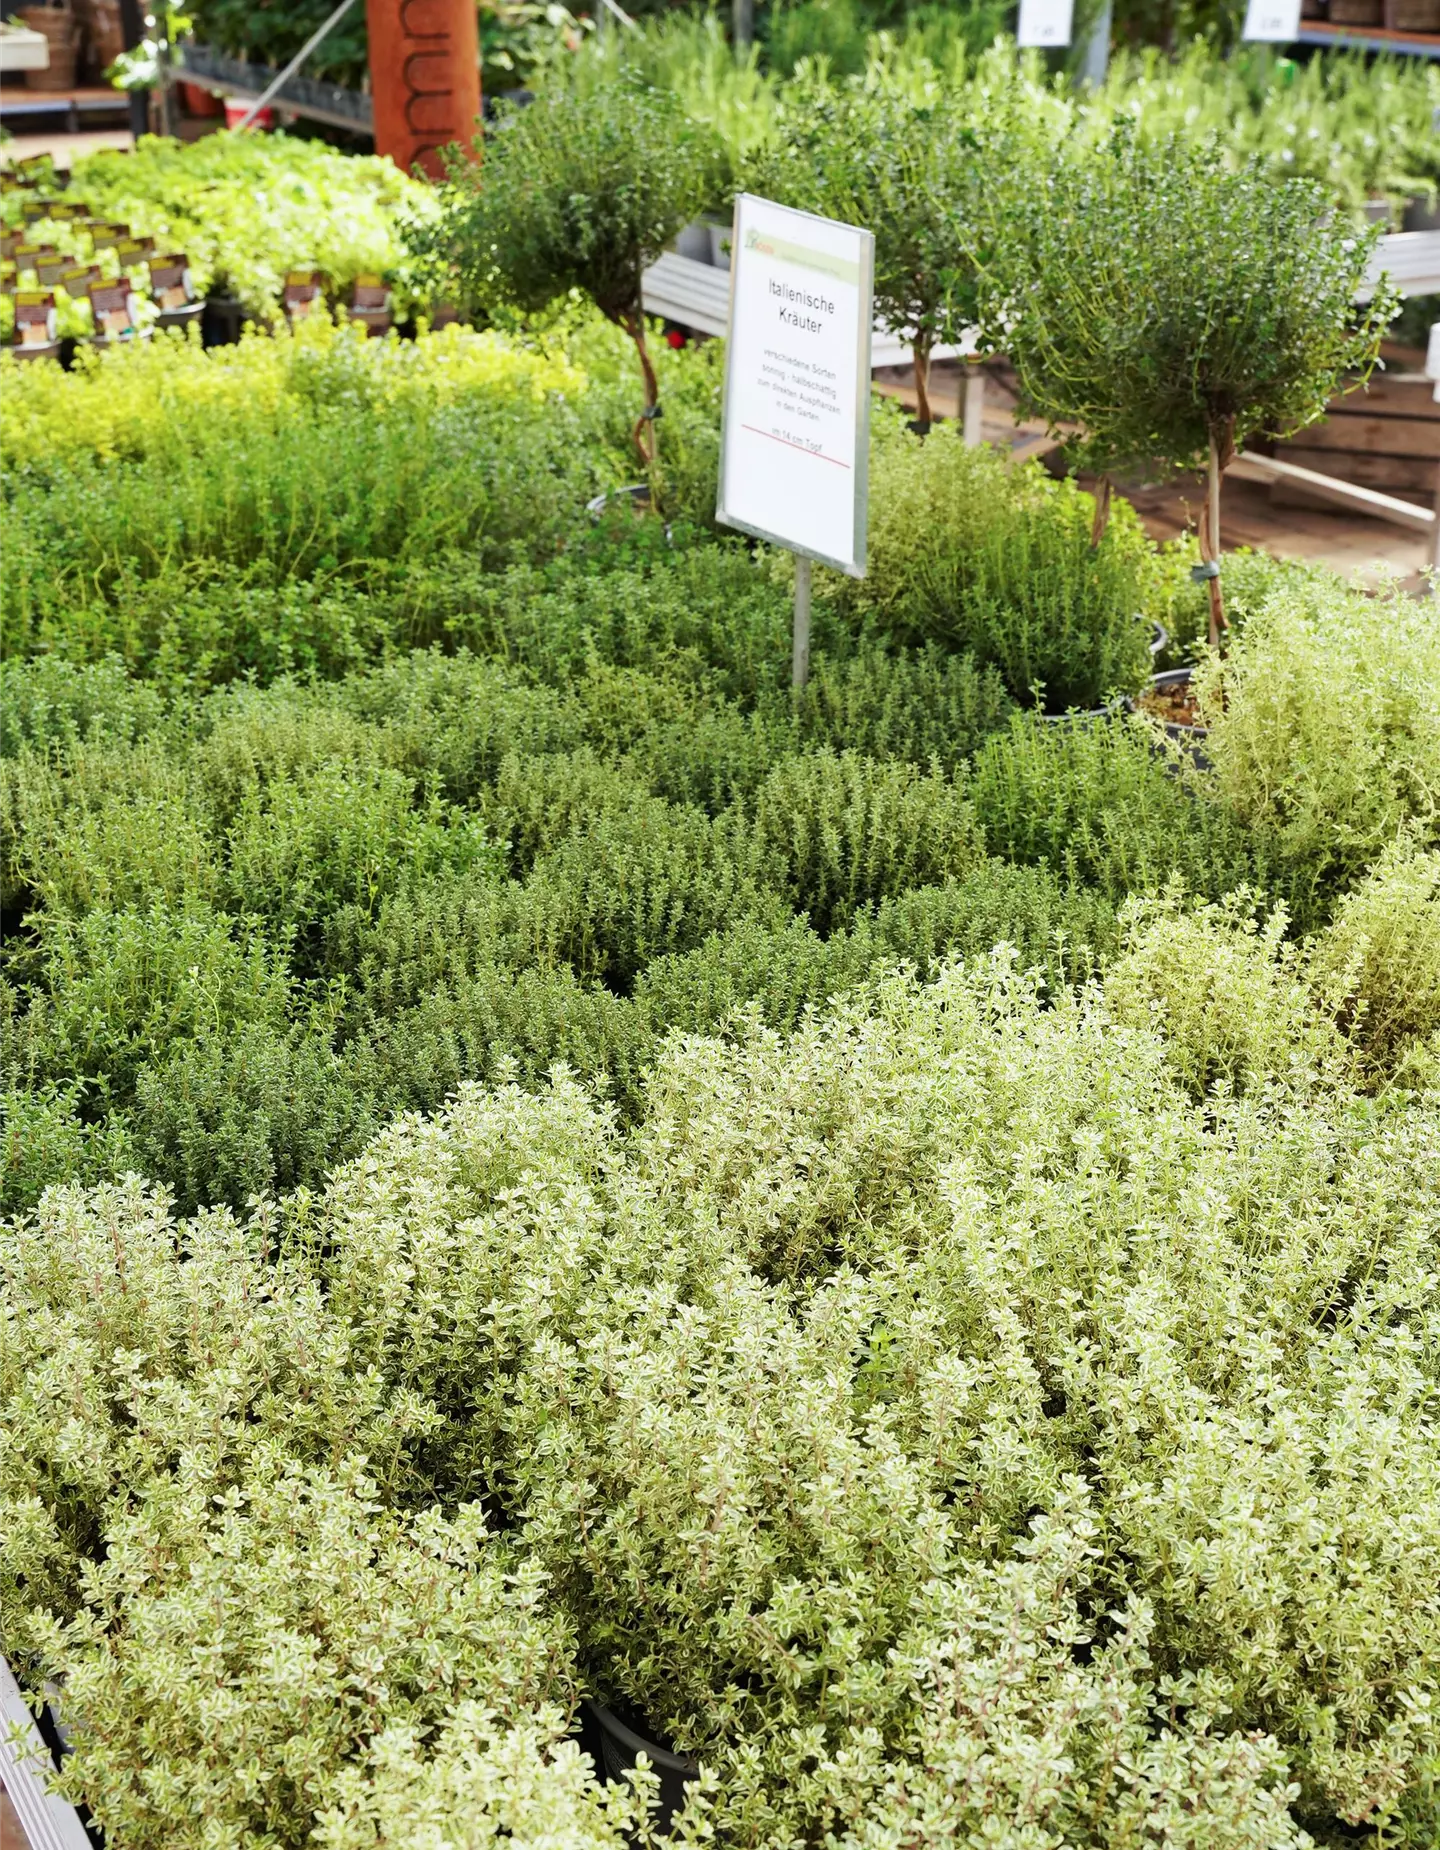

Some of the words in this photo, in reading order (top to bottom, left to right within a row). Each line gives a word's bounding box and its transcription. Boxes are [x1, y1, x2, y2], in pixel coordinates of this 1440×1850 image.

[768, 277, 835, 315] Italienische
[778, 305, 823, 334] Kräuter
[762, 363, 786, 381] sonnig
[763, 348, 810, 371] verschiedene
[811, 363, 837, 380] Sorten
[772, 381, 797, 398] direkten
[799, 392, 841, 415] Auspflanzen
[783, 401, 795, 412] den
[796, 406, 820, 421] Garten
[782, 429, 791, 440] 14
[792, 434, 804, 445] cm
[805, 437, 824, 452] Topf
